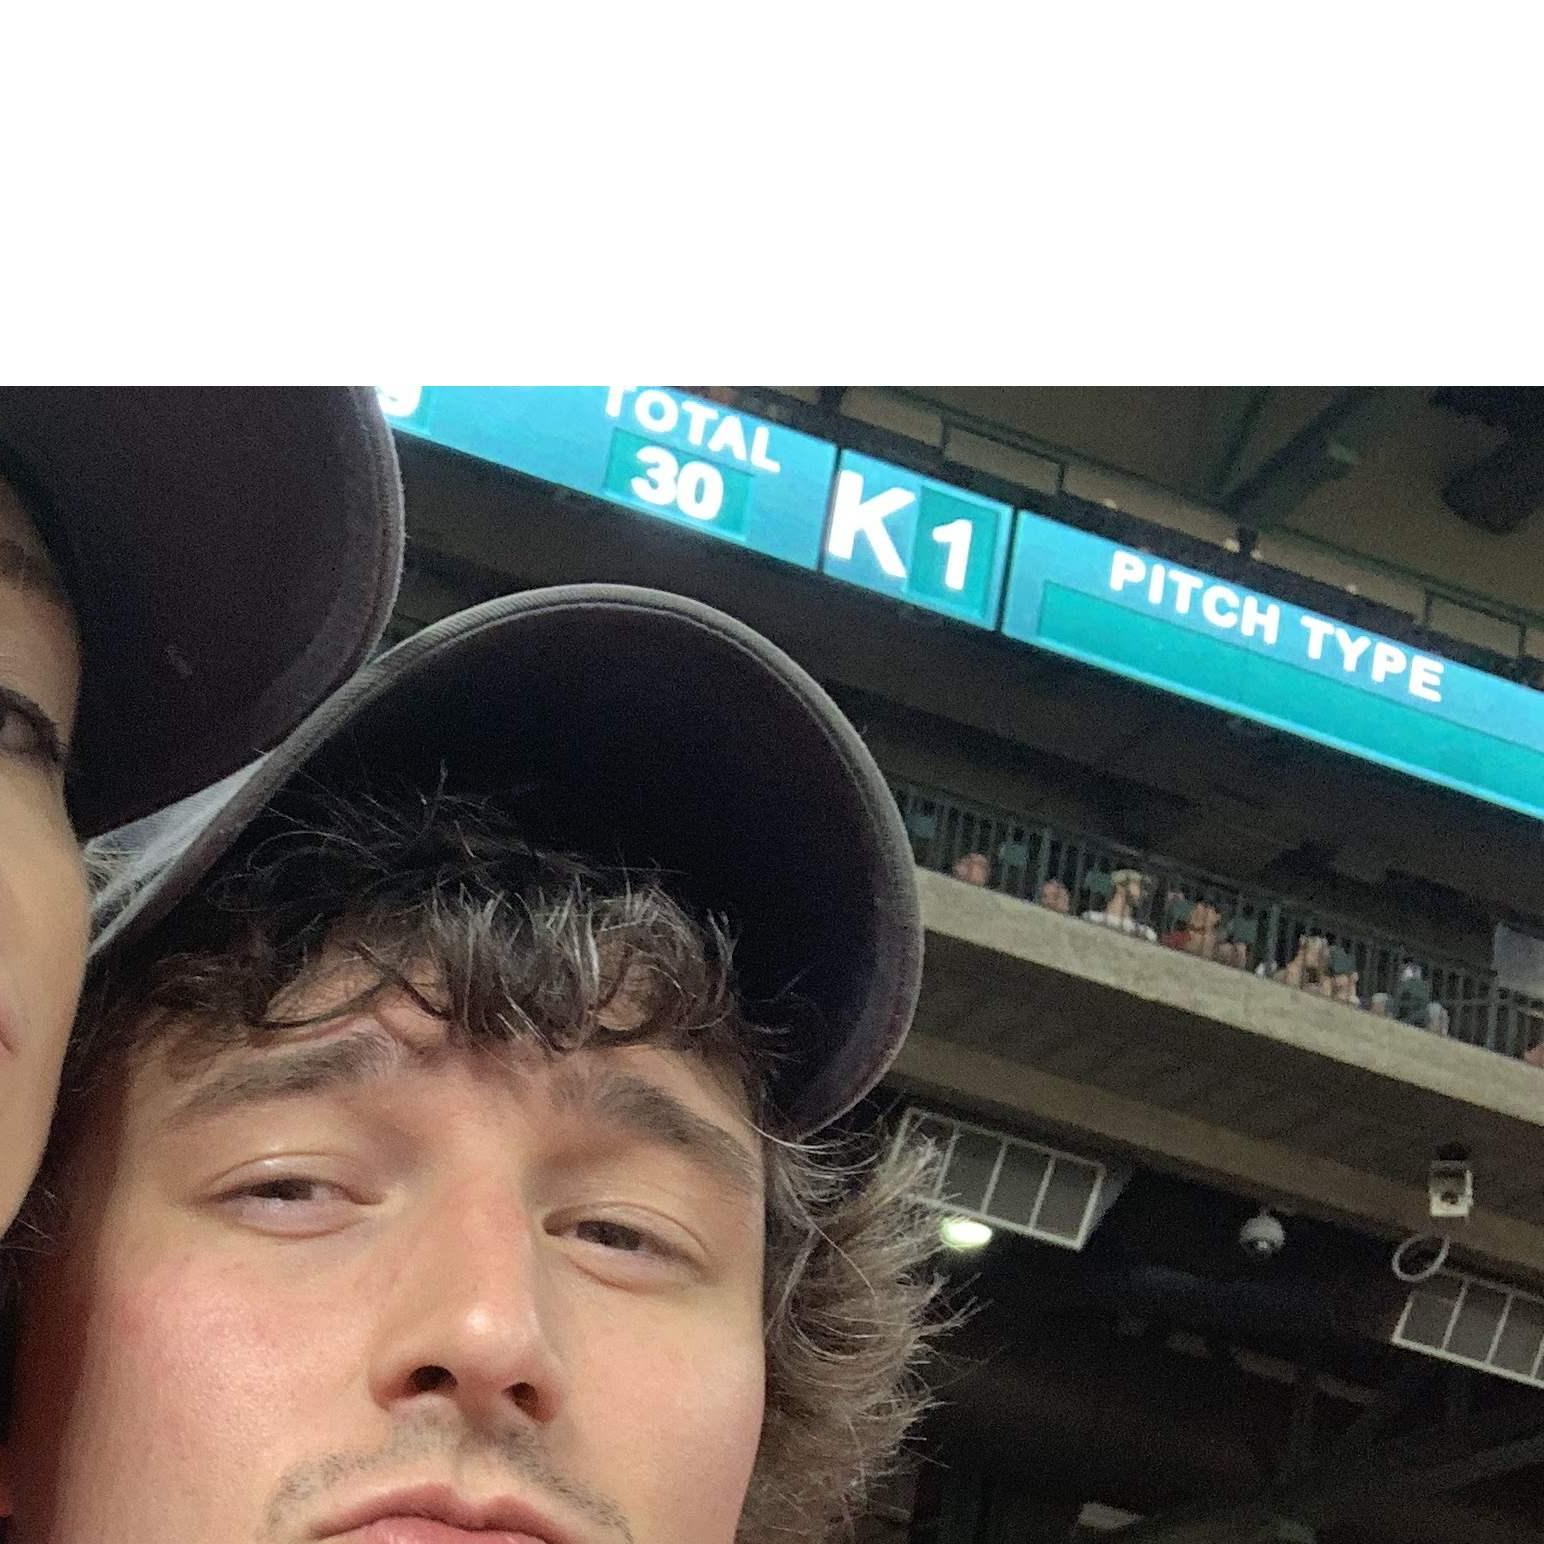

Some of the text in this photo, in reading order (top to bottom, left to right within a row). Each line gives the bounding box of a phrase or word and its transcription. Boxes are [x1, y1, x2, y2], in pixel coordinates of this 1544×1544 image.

[606, 386, 781, 473] TOTAL
[631, 445, 724, 520] 30
[828, 469, 973, 591] K 1
[1109, 550, 1444, 703] PITCH TYPE
